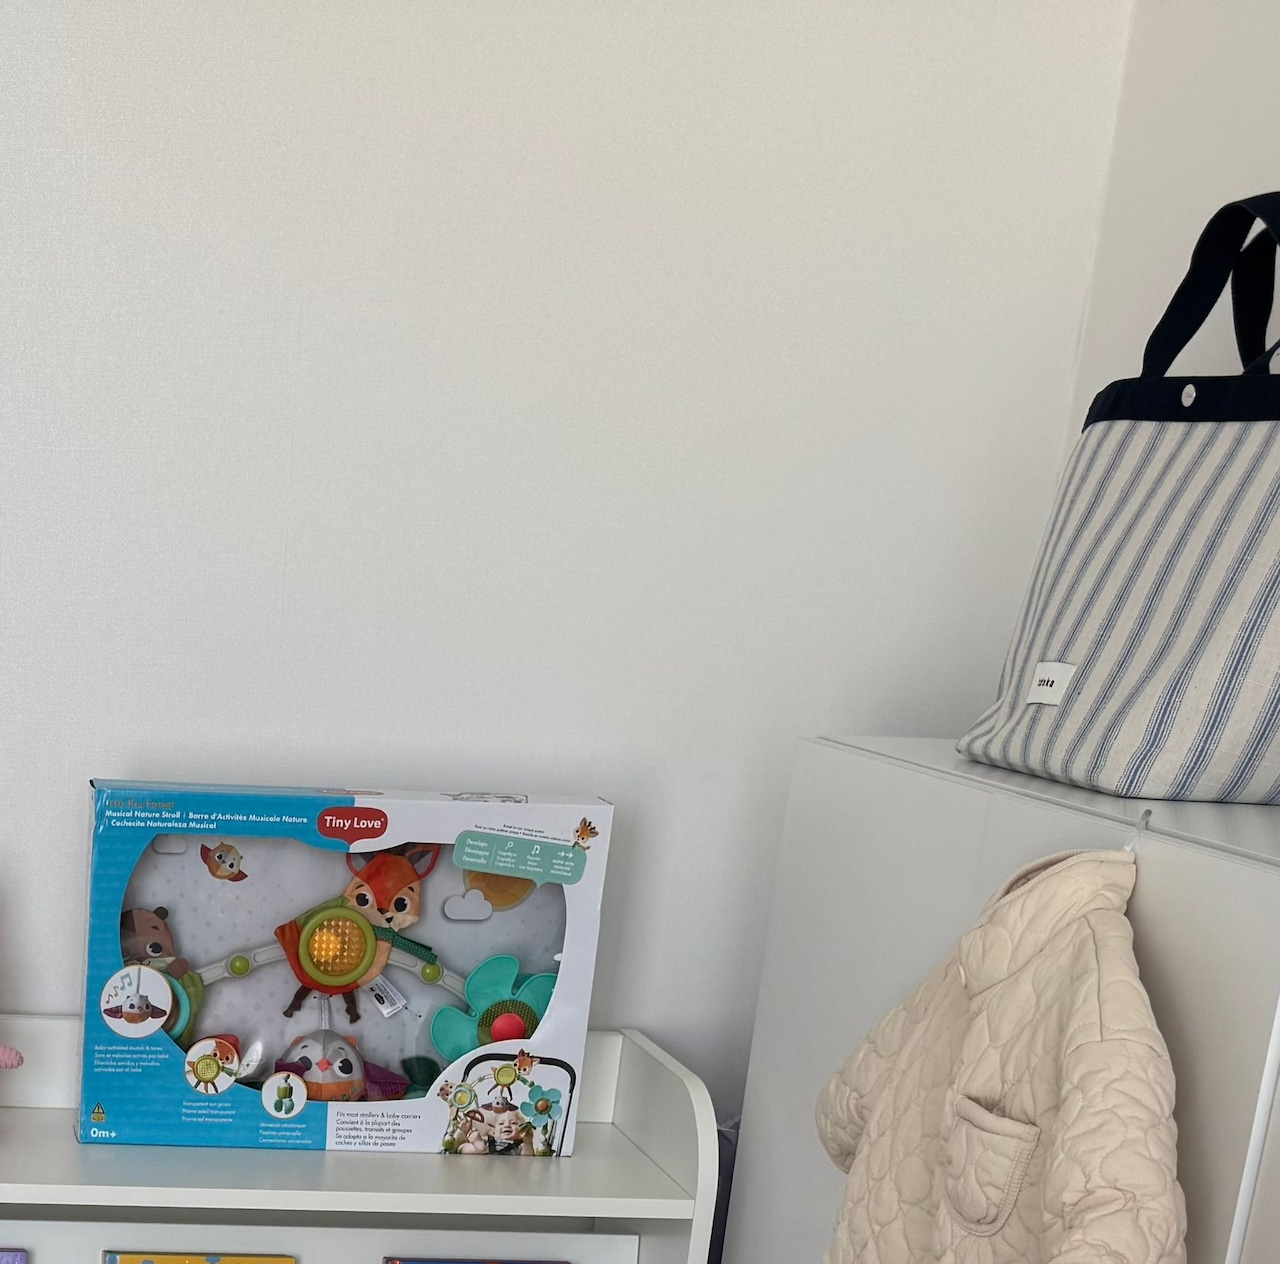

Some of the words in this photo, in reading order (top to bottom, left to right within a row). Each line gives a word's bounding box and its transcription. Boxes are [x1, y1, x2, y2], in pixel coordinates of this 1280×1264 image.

[134, 810, 160, 818] Nature
[249, 814, 280, 822] Musicale
[282, 815, 308, 823] Nature
[111, 819, 145, 827] Cochecito
[146, 820, 187, 828] Naturaleza
[188, 821, 217, 829] Musical
[324, 816, 351, 830] Tiny
[353, 816, 382, 829] Love
[90, 1127, 117, 1138] 0m+
